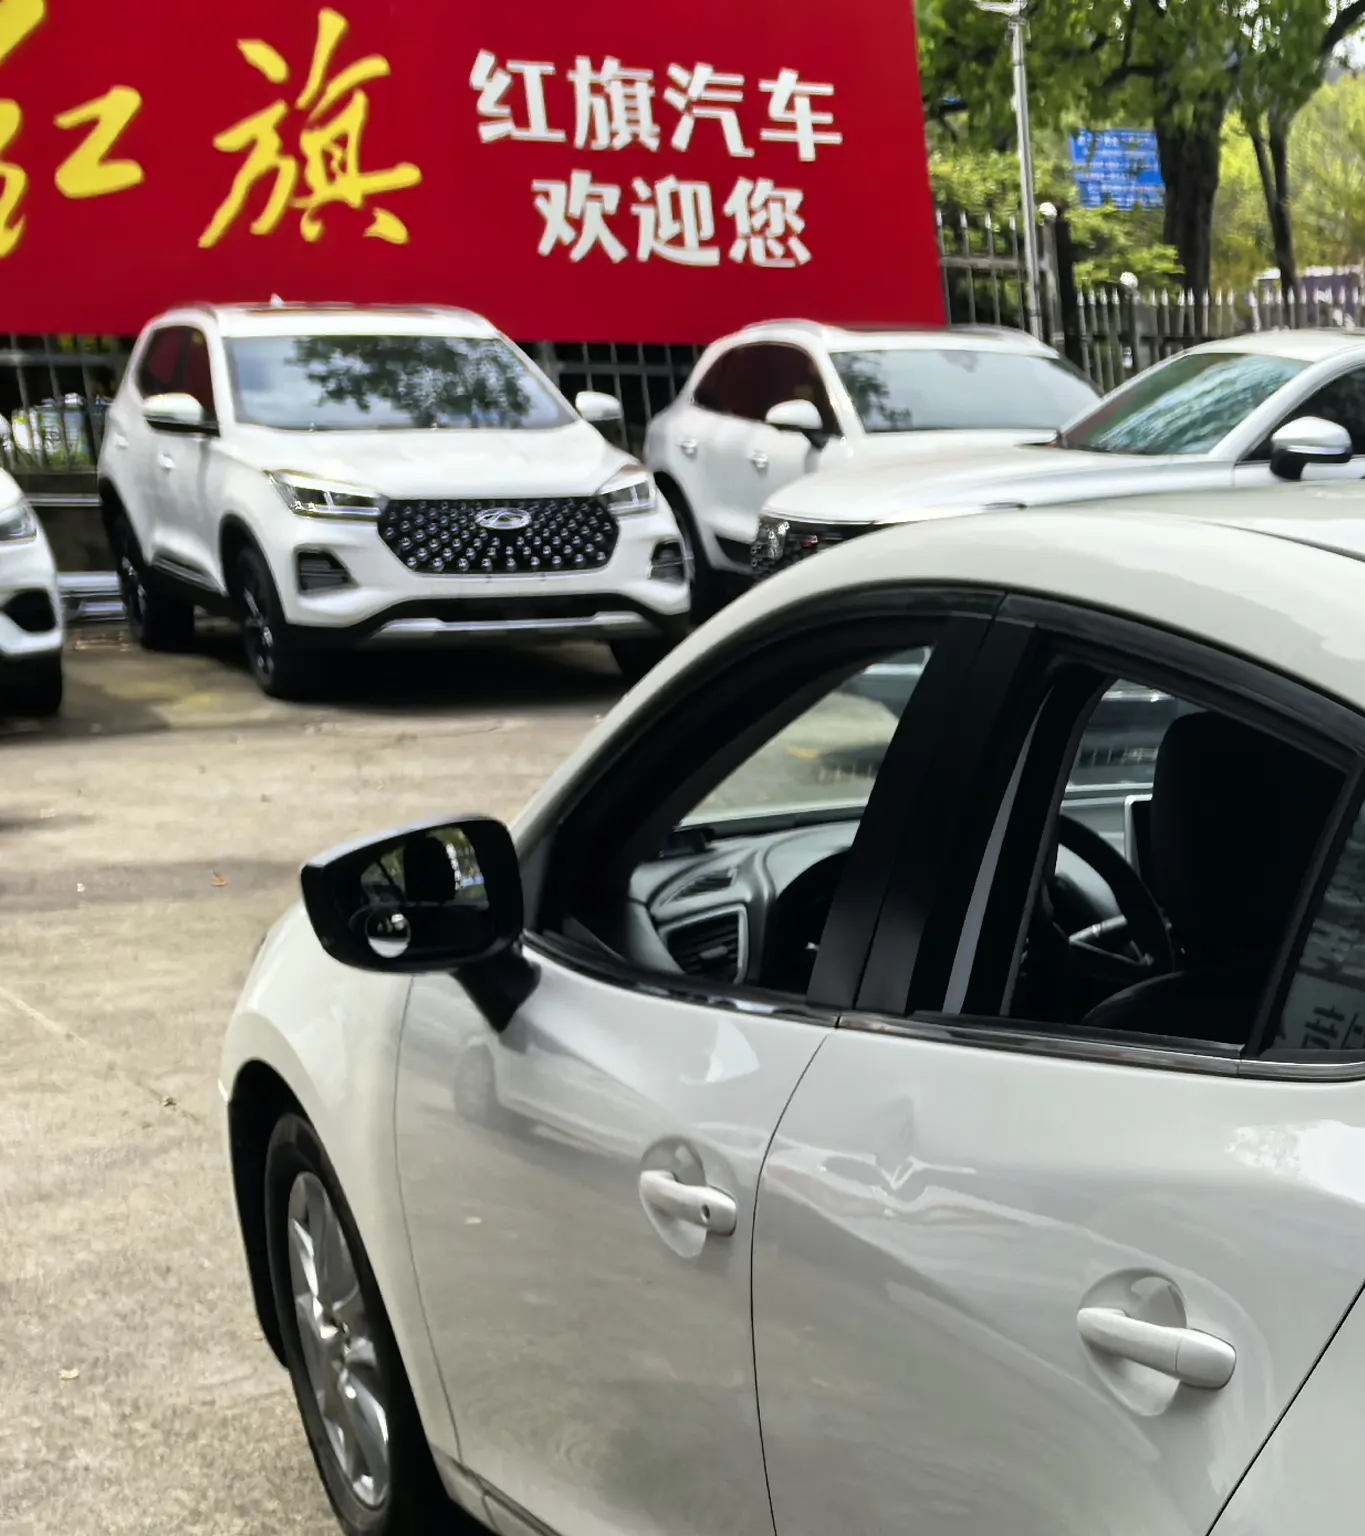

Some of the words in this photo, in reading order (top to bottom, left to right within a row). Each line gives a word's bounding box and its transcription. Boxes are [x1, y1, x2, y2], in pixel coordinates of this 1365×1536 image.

[469, 50, 844, 162] 红旗汽车
[532, 170, 813, 268] 欢迎您
